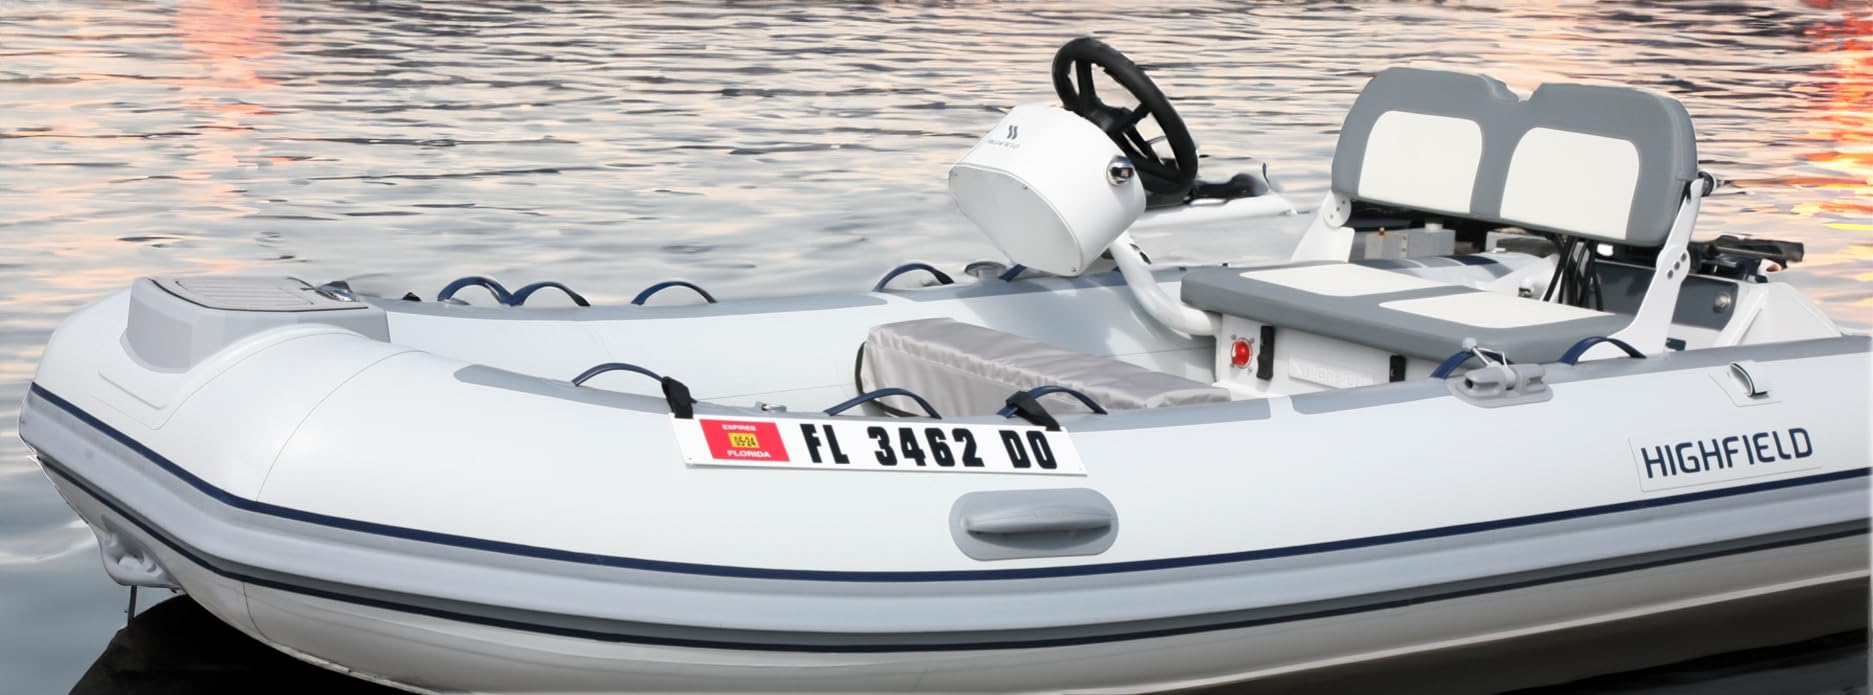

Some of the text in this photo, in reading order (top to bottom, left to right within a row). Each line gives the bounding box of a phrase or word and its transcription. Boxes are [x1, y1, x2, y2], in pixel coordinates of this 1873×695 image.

[727, 450, 771, 458] FLORIDA
[733, 436, 757, 447] 05-24
[800, 423, 1058, 469] FL 3462 DO
[1641, 427, 1813, 479] HIGHFIELD
